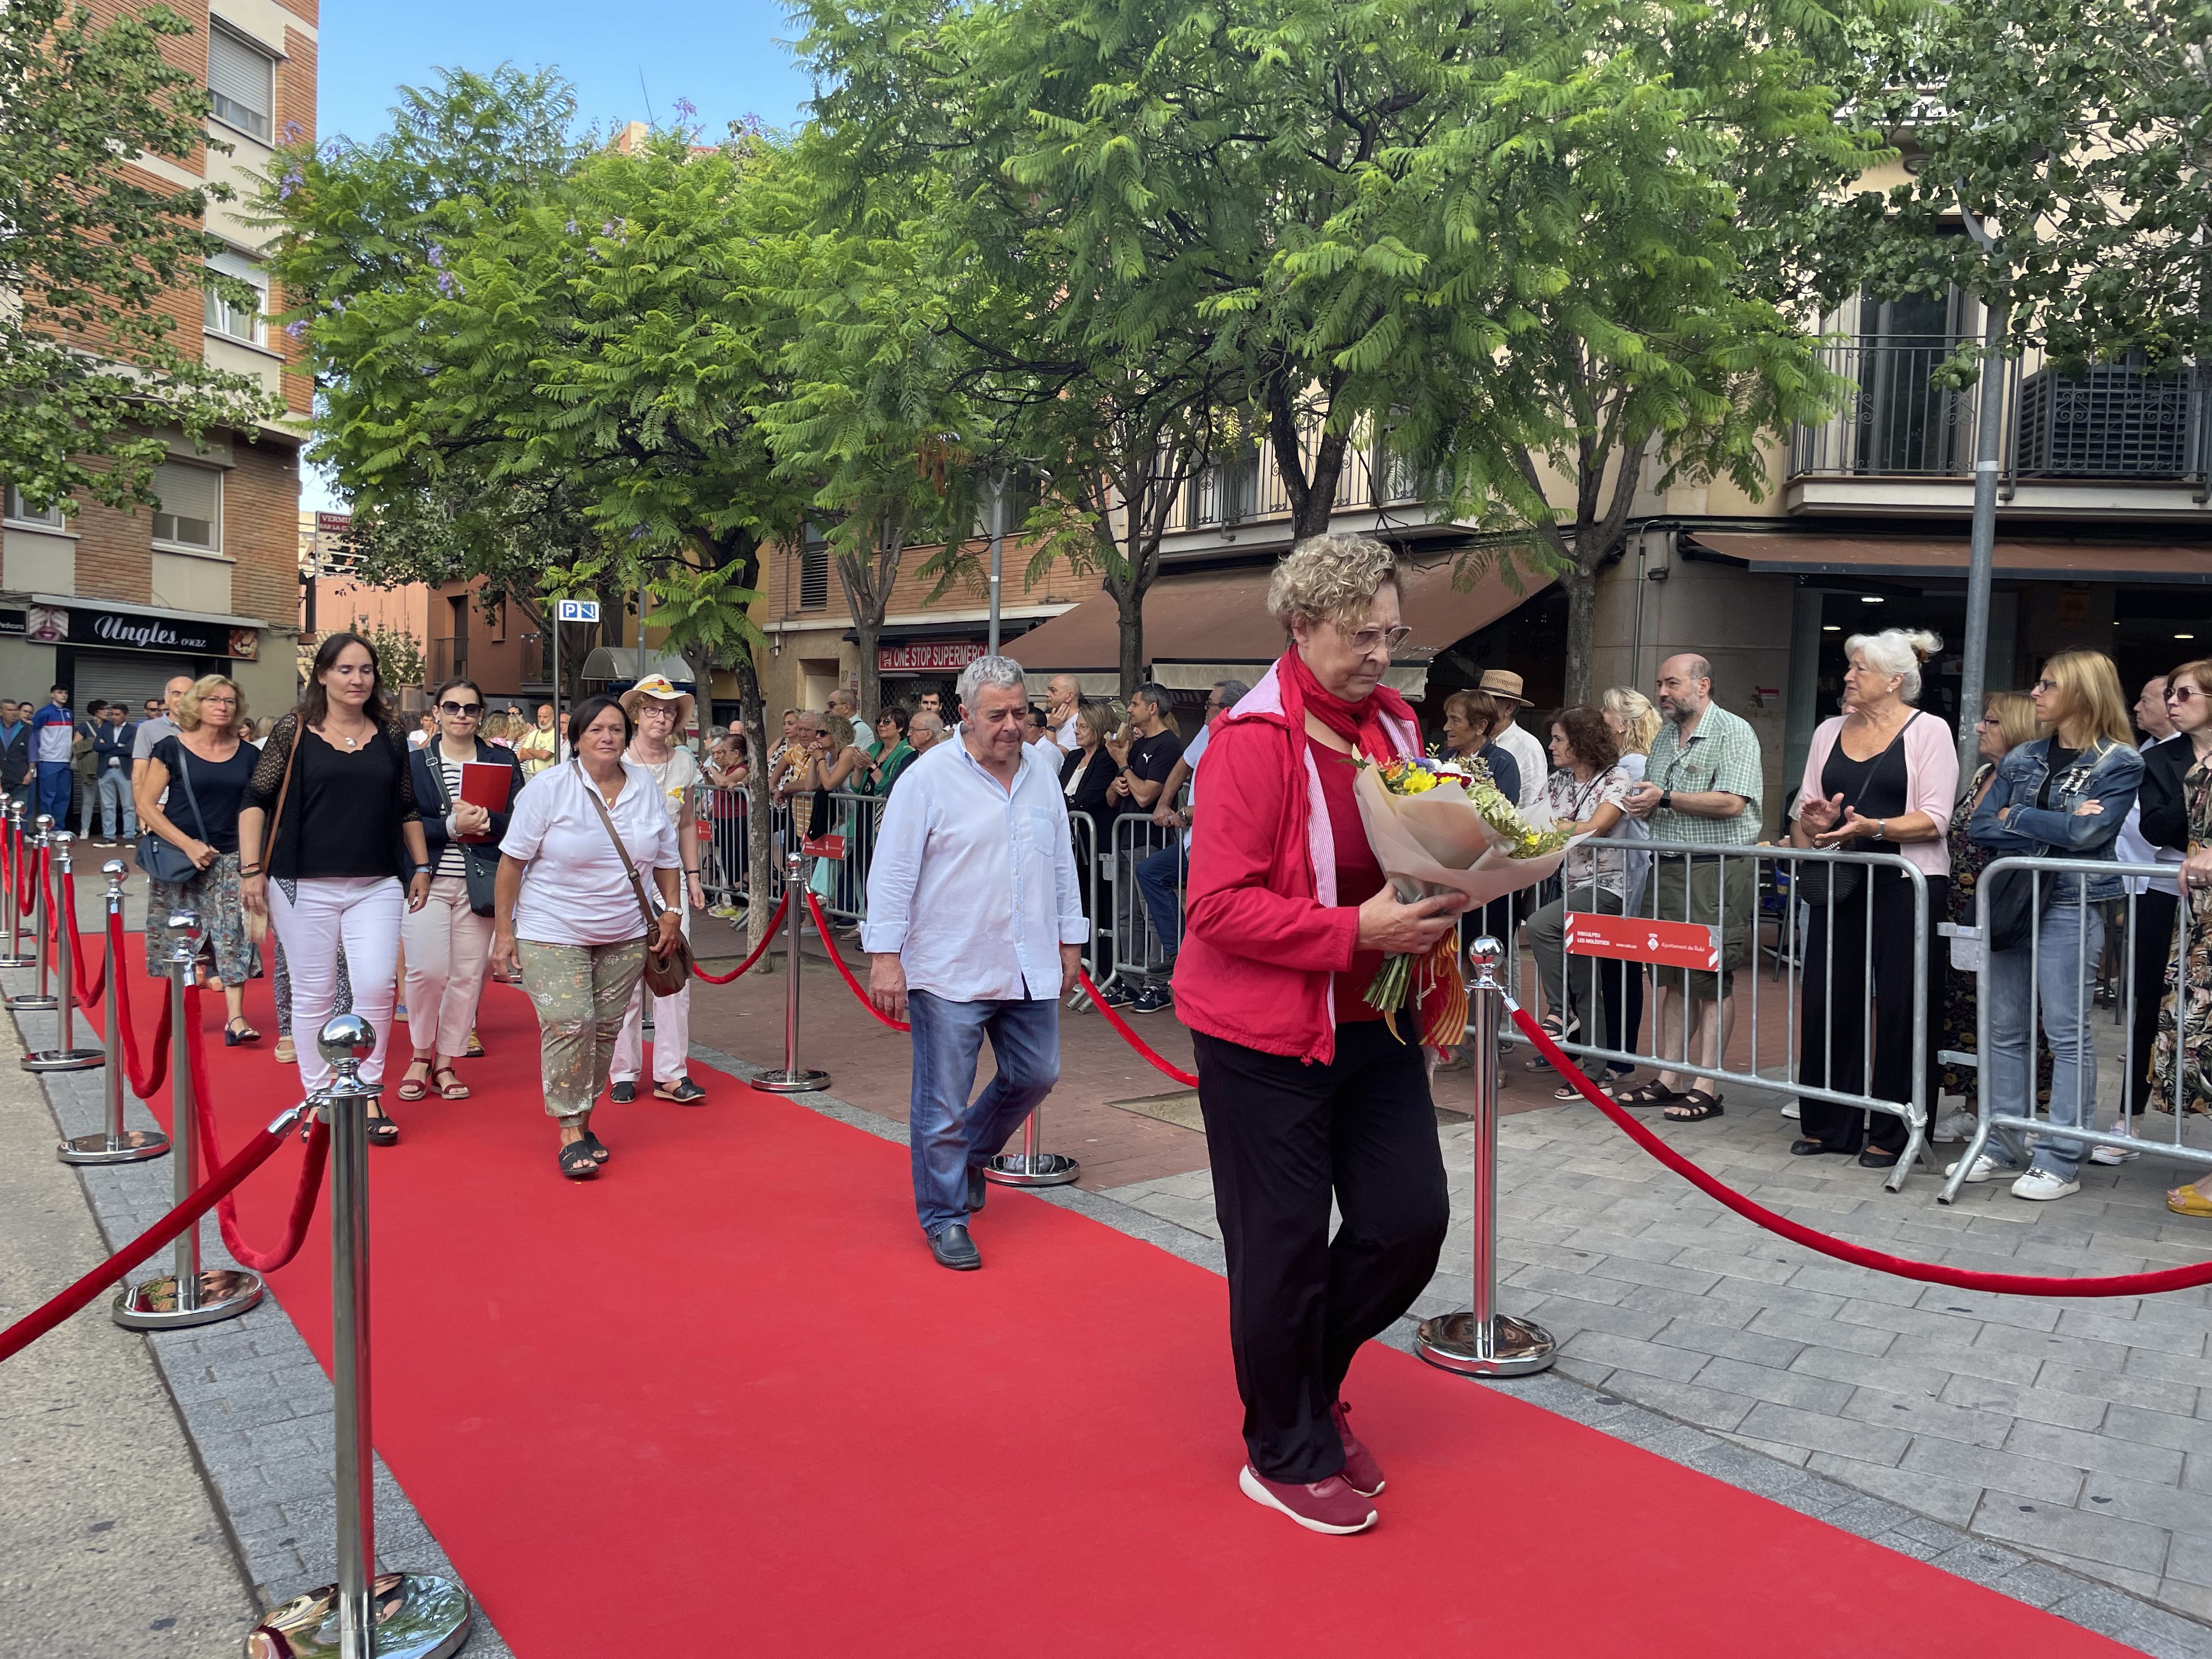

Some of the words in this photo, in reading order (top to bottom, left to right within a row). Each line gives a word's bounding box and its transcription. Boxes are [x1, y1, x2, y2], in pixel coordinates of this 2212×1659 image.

[321, 515, 352, 523] VERMU
[566, 604, 575, 617] P
[94, 615, 178, 647] Ungles
[894, 648, 910, 667] ONE
[911, 647, 932, 667] STOP
[933, 645, 990, 667] SUPERMERCA
